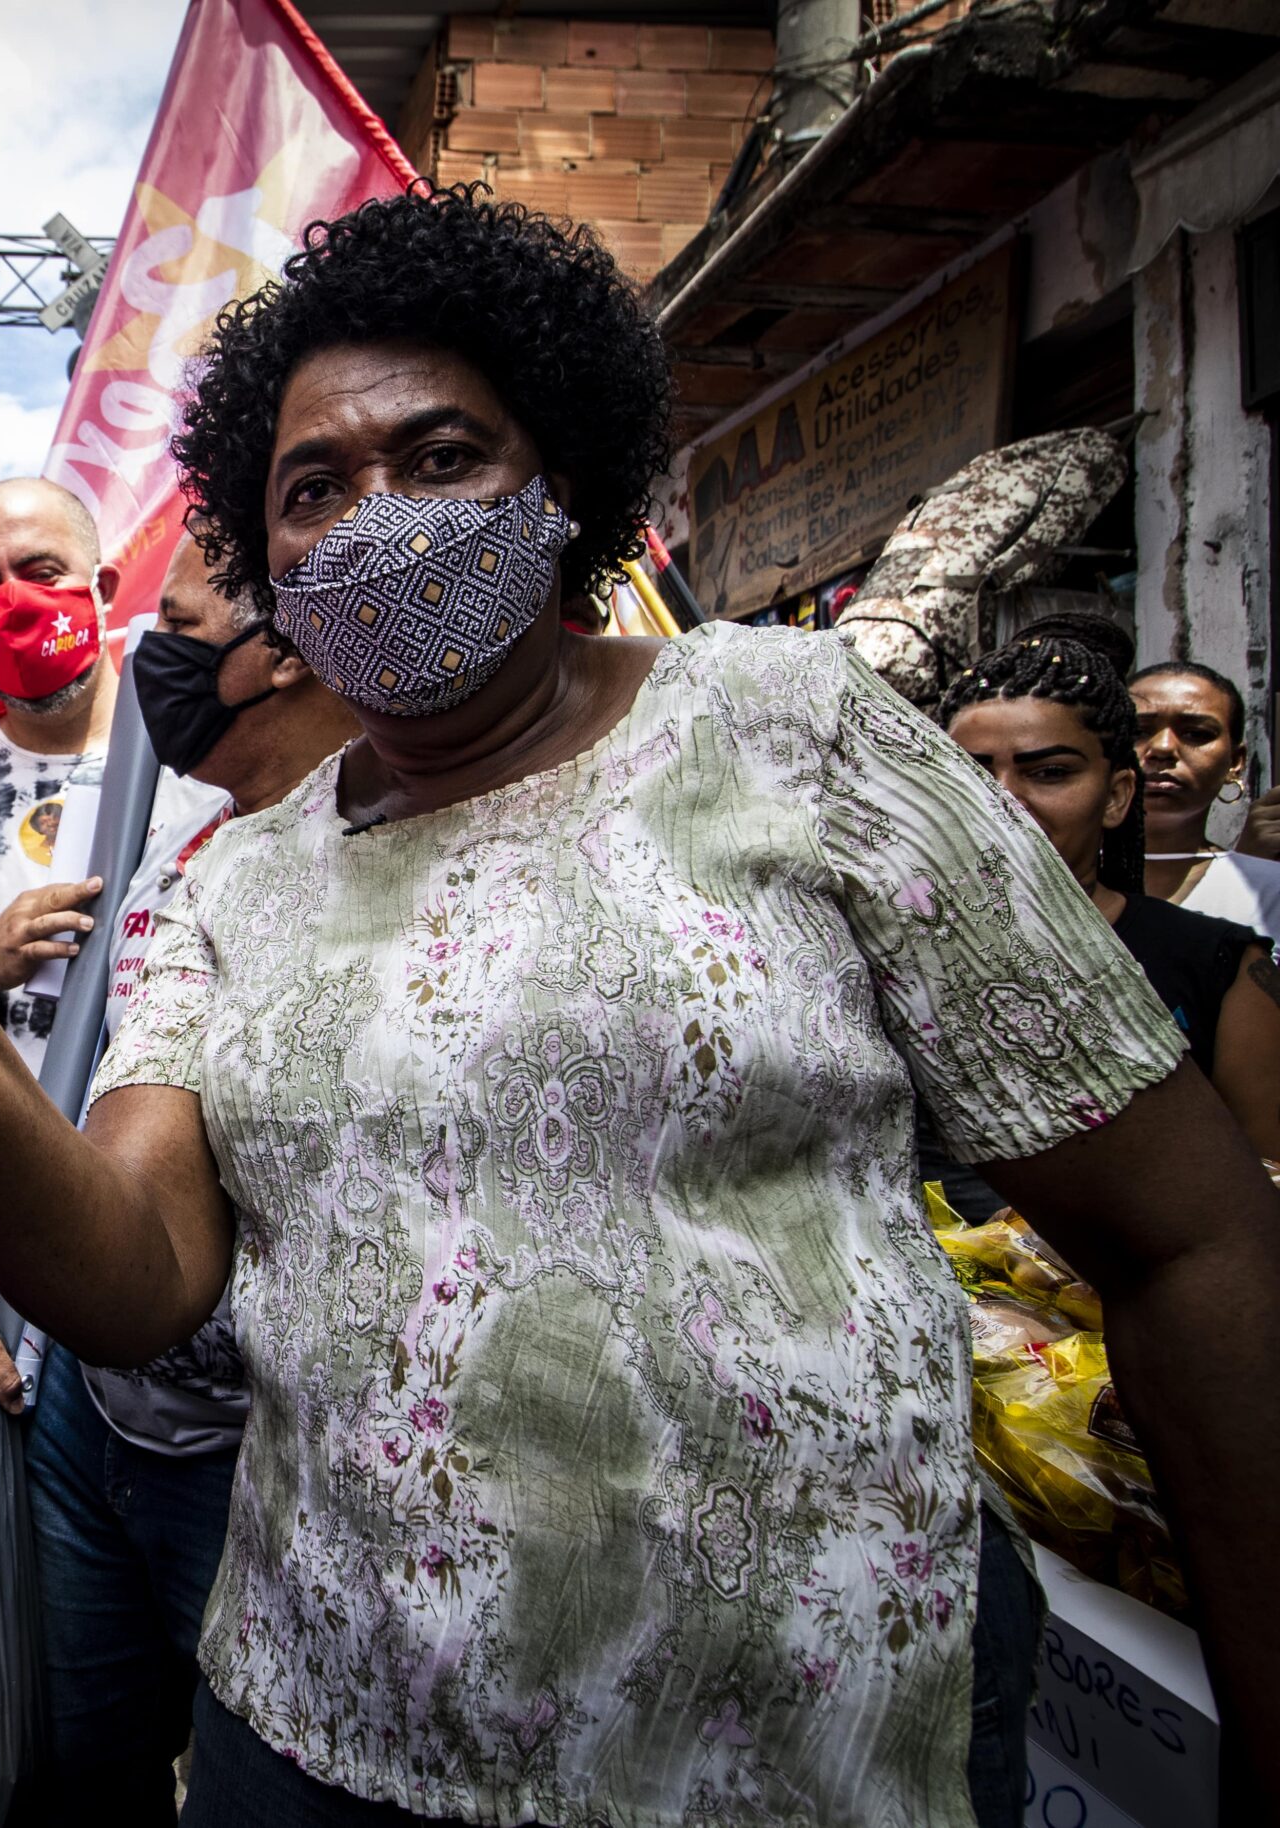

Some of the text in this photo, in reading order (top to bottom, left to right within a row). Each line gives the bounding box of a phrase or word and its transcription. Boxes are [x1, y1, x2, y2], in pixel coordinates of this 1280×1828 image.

[60, 228, 83, 256] VIA
[815, 339, 960, 449] Utilidades
[836, 408, 910, 467] Fontes
[744, 485, 833, 547] Controles
[843, 436, 922, 495] Antenas
[744, 534, 799, 575] Cabos
[41, 628, 89, 657] CARIOCA
[122, 909, 156, 938] FA
